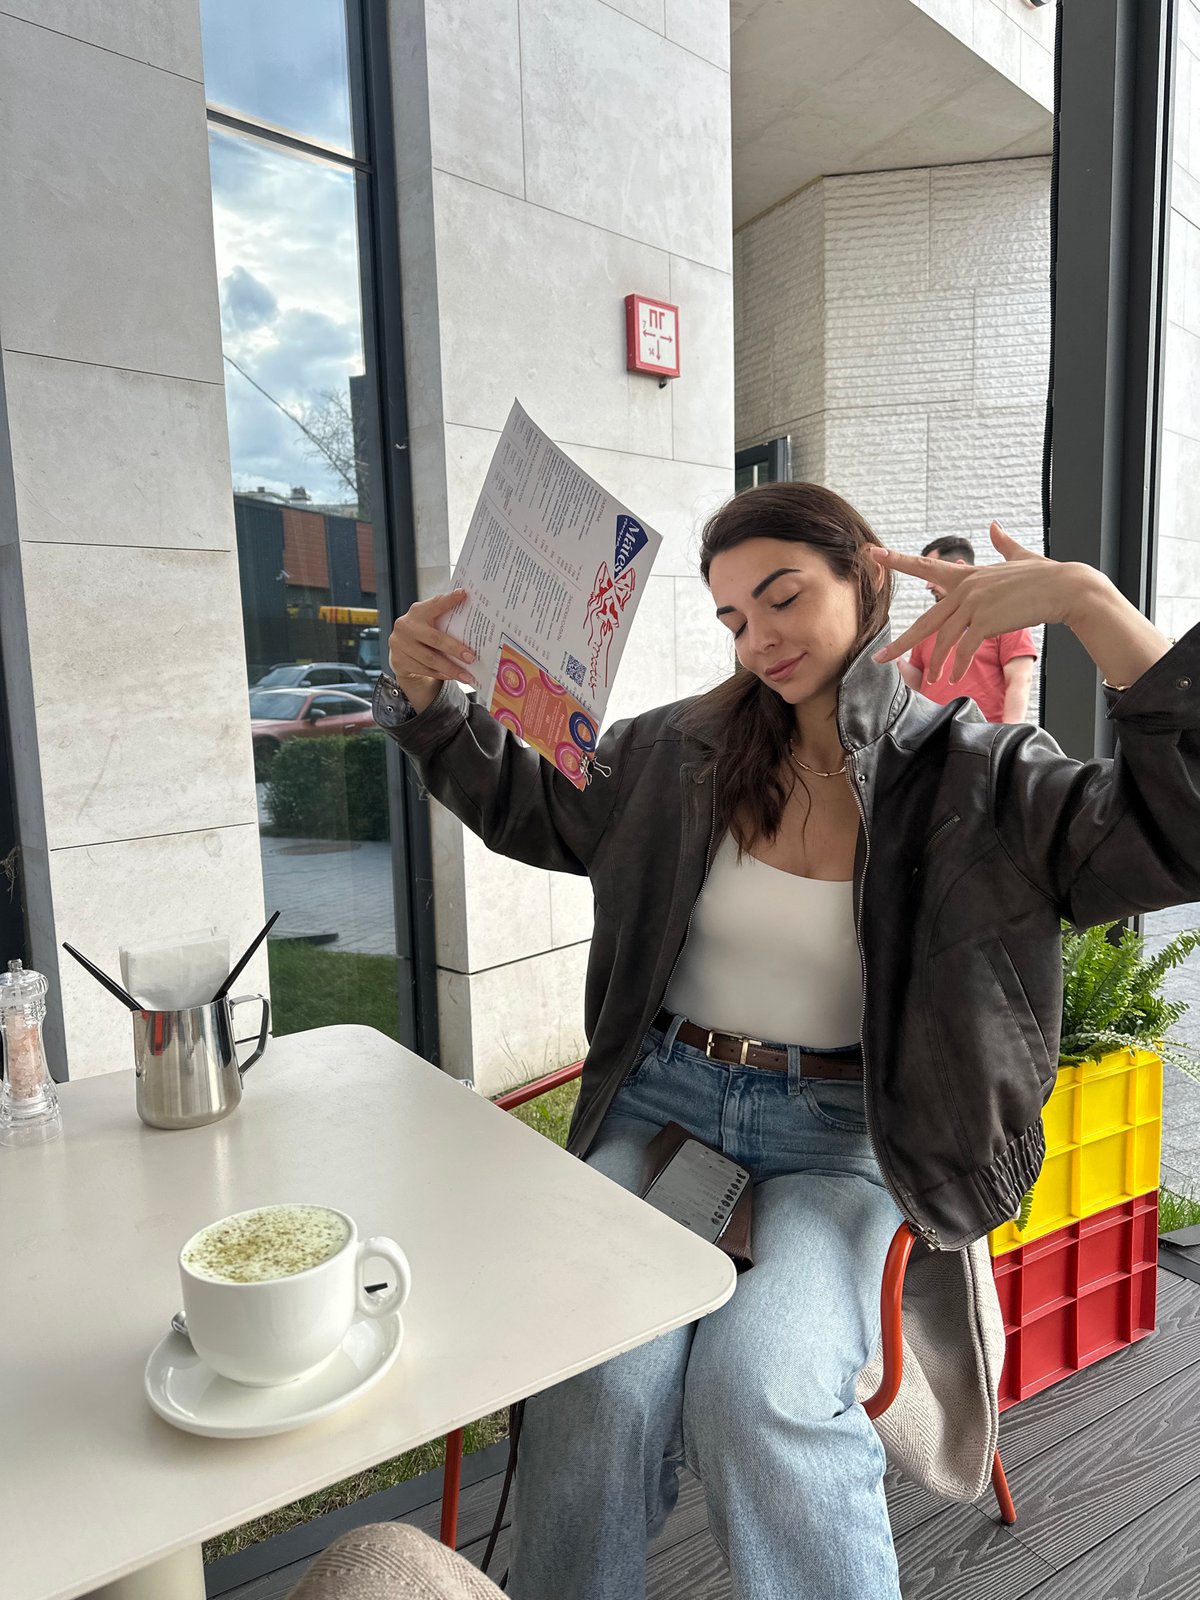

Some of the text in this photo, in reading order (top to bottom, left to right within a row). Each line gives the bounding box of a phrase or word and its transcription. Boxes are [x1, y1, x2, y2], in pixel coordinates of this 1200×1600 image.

[642, 319, 647, 329] 7
[649, 309, 665, 330] ПГ
[614, 522, 640, 573] Mátes
